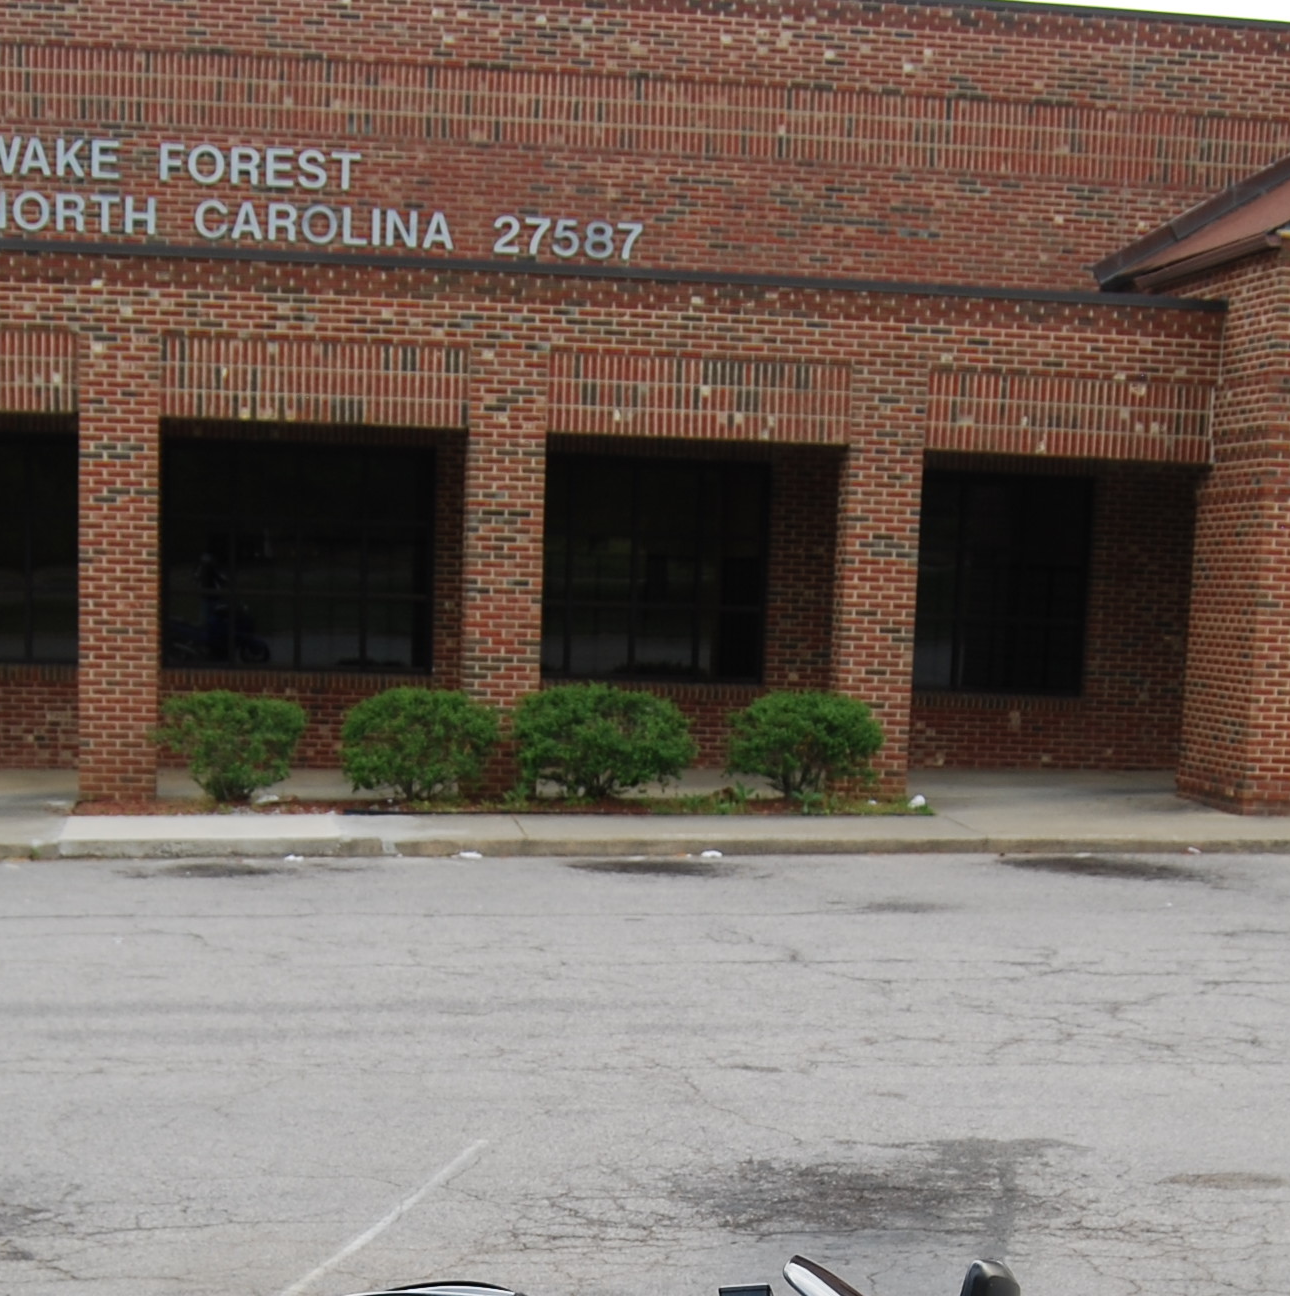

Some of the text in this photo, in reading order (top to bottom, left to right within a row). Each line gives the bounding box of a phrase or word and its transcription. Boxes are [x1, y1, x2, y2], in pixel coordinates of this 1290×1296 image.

[159, 141, 362, 191] FOREST
[194, 199, 454, 251] CAROLINA
[493, 214, 644, 260] 27587
